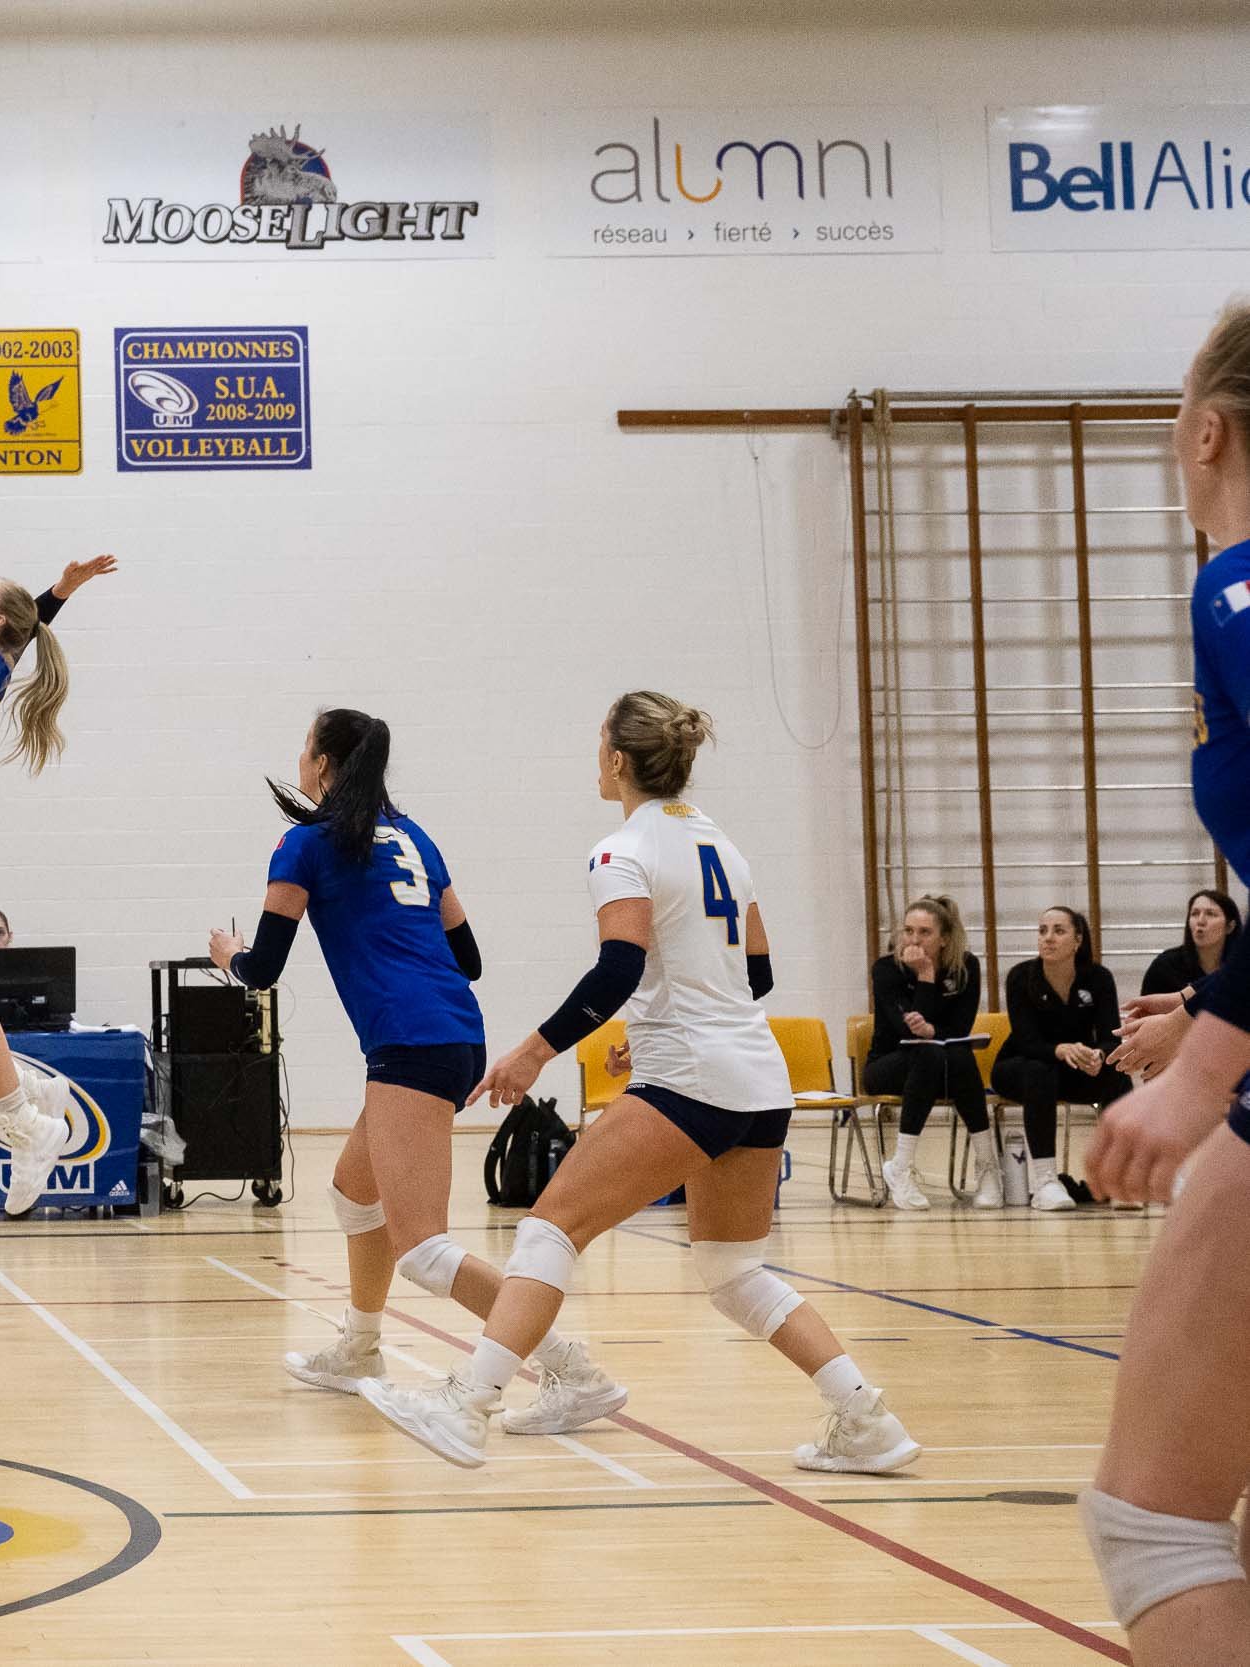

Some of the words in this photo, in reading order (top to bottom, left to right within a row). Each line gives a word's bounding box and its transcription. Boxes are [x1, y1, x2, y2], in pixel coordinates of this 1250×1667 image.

[591, 117, 894, 203] alumni
[1144, 140, 1250, 211] Ali
[593, 223, 667, 244] réseau
[714, 221, 772, 242] fierté
[816, 220, 894, 241] succès
[126, 340, 295, 360] CHAMPIONNES
[214, 376, 285, 400] S.U.A.
[206, 403, 296, 422] 2008-2009
[130, 437, 296, 458] VOLLEYBALL
[372, 825, 431, 907] 3
[696, 842, 740, 947] 4
